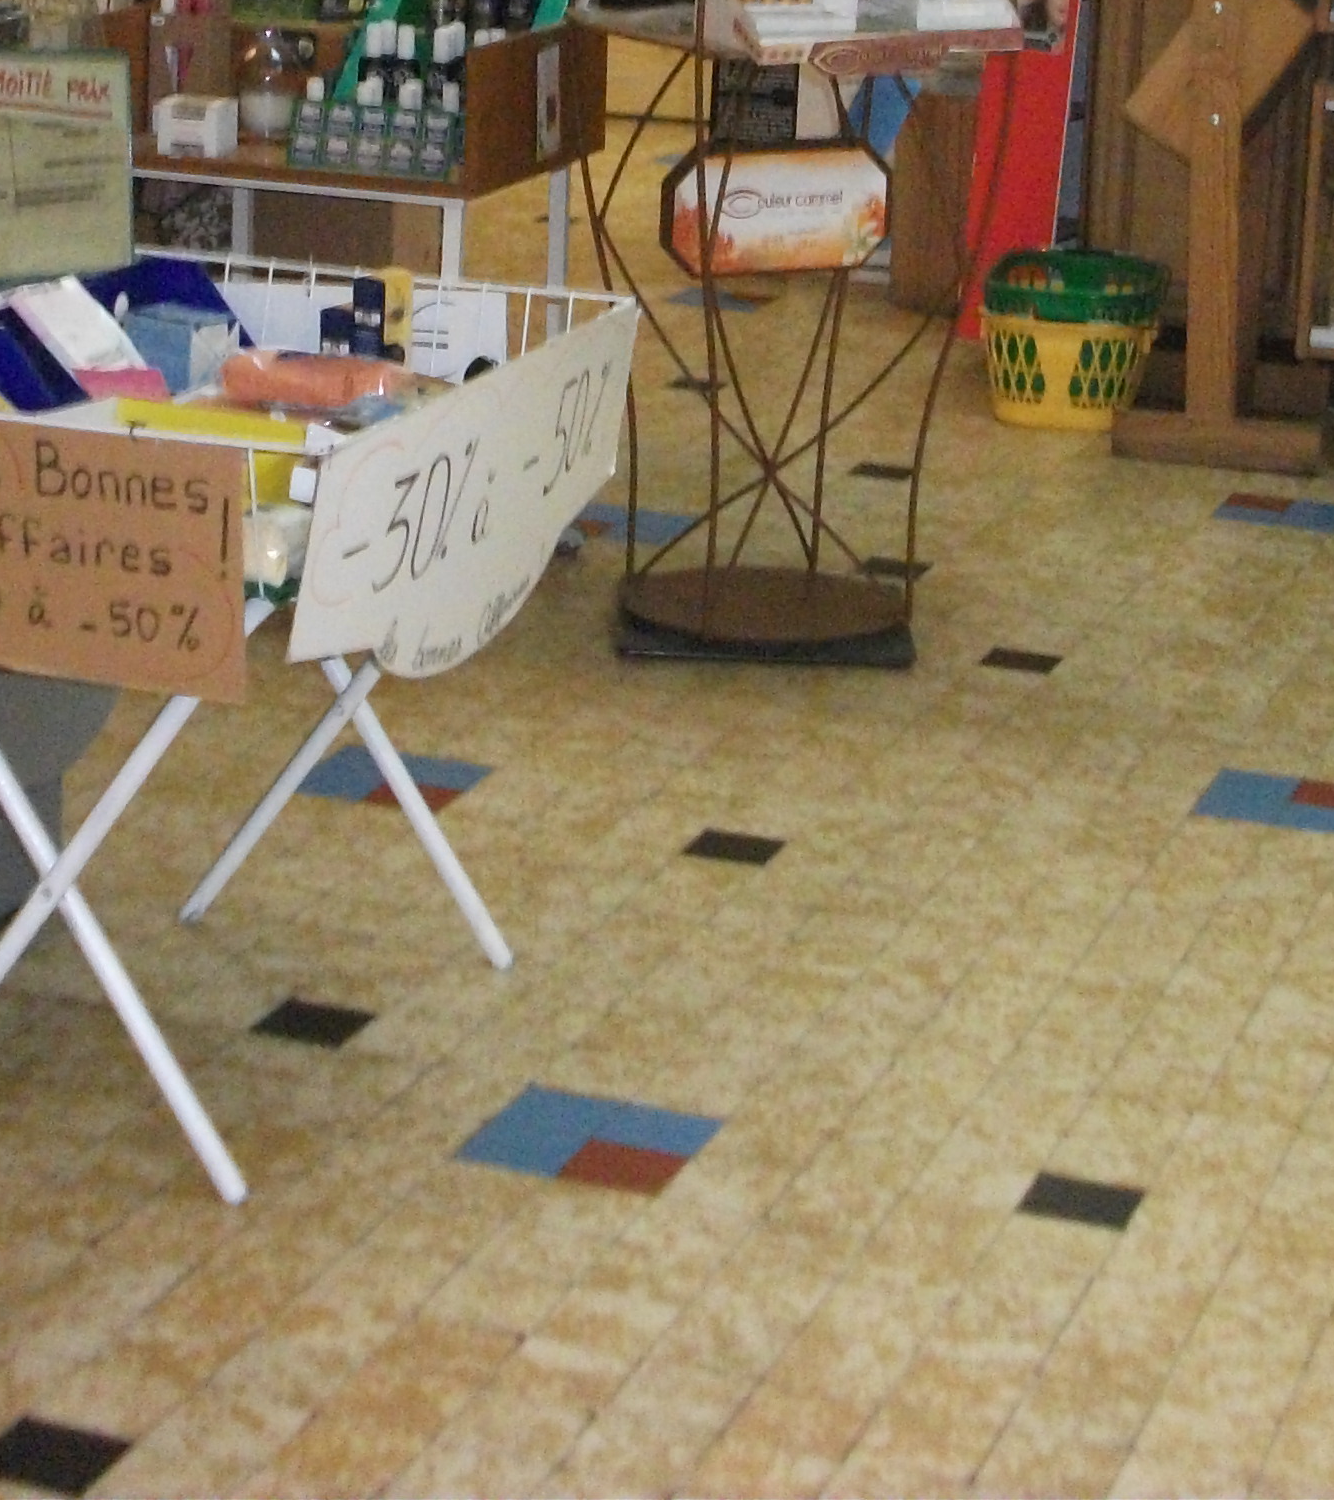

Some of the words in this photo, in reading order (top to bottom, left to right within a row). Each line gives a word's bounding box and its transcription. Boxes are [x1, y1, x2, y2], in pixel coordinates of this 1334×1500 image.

[34, 438, 210, 516] Bonnes
[342, 437, 481, 595] -30%
[522, 359, 613, 497] -50%
